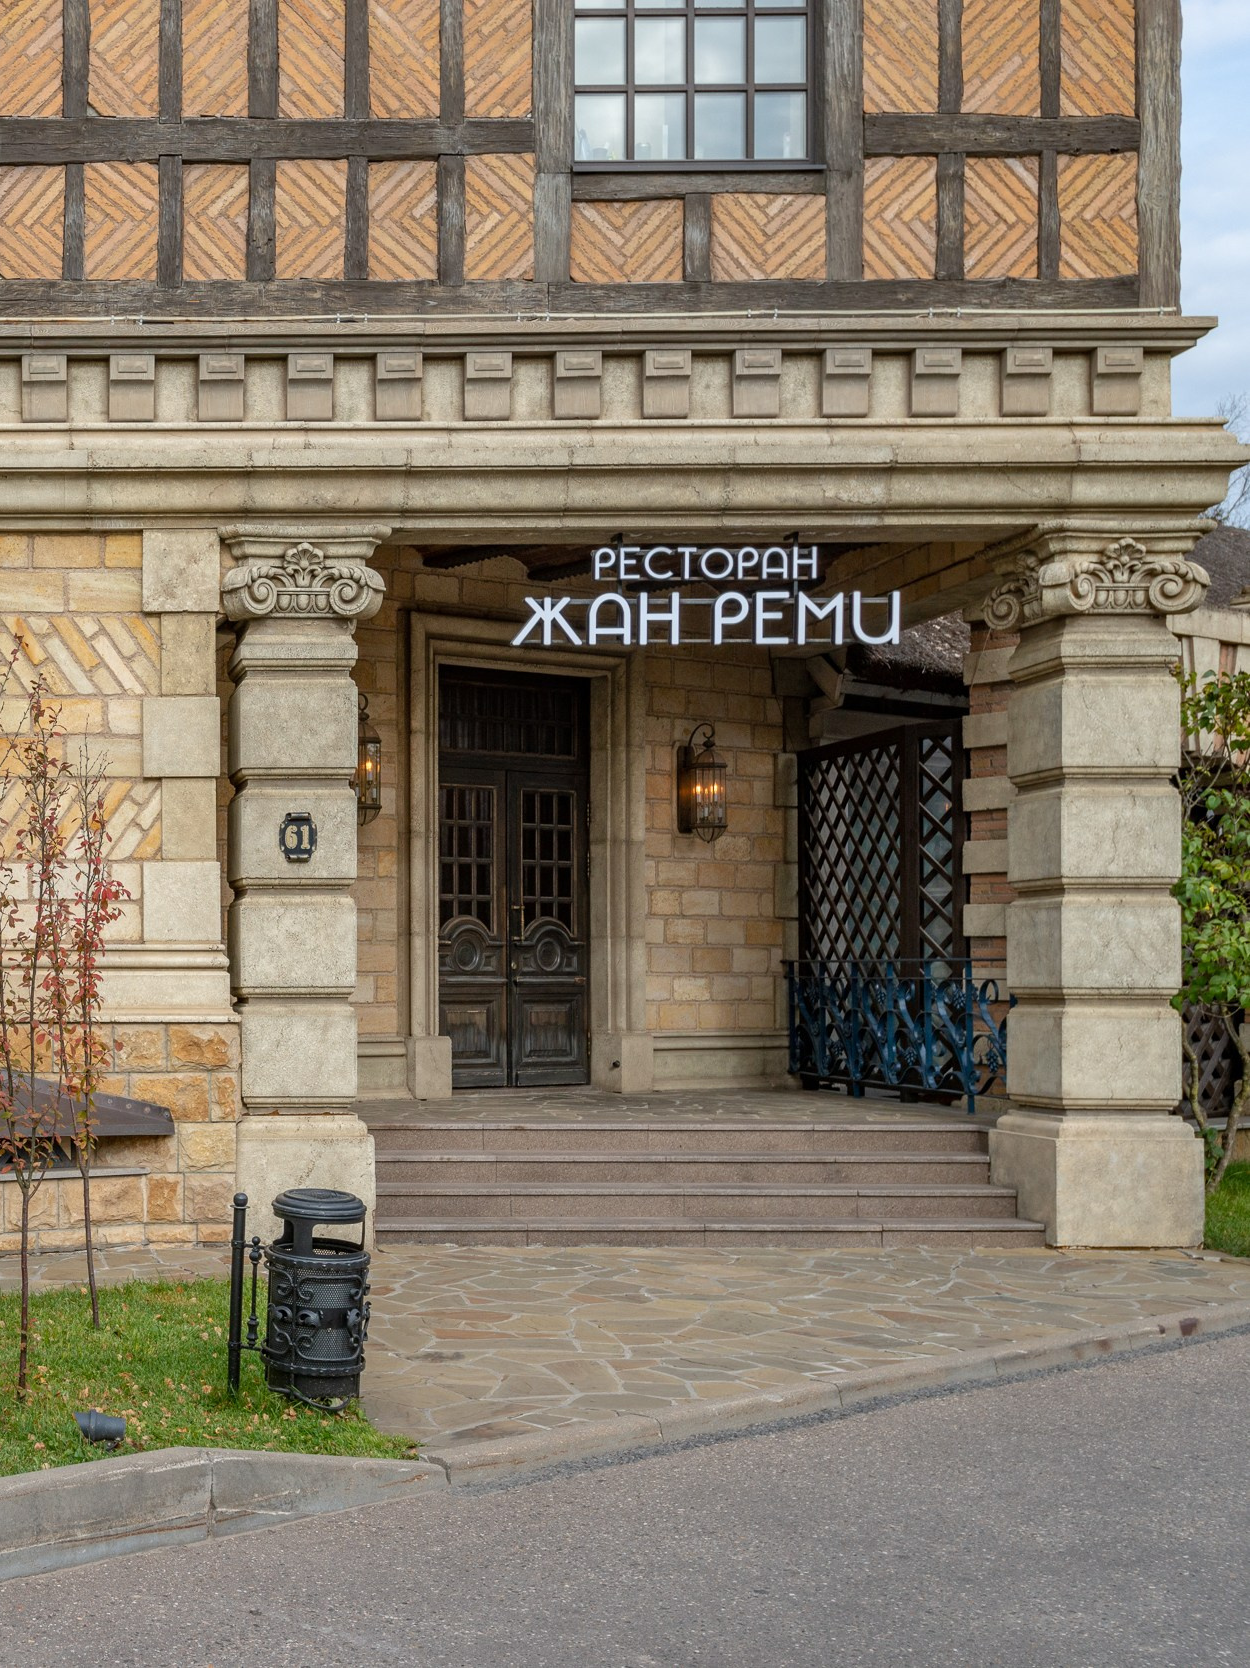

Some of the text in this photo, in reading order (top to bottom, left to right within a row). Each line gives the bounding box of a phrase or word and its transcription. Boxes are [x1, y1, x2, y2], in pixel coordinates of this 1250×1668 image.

[593, 546, 818, 580] РЕСТОРАН
[511, 590, 901, 645] ЖАН РЕМИ
[284, 825, 310, 850] 61
